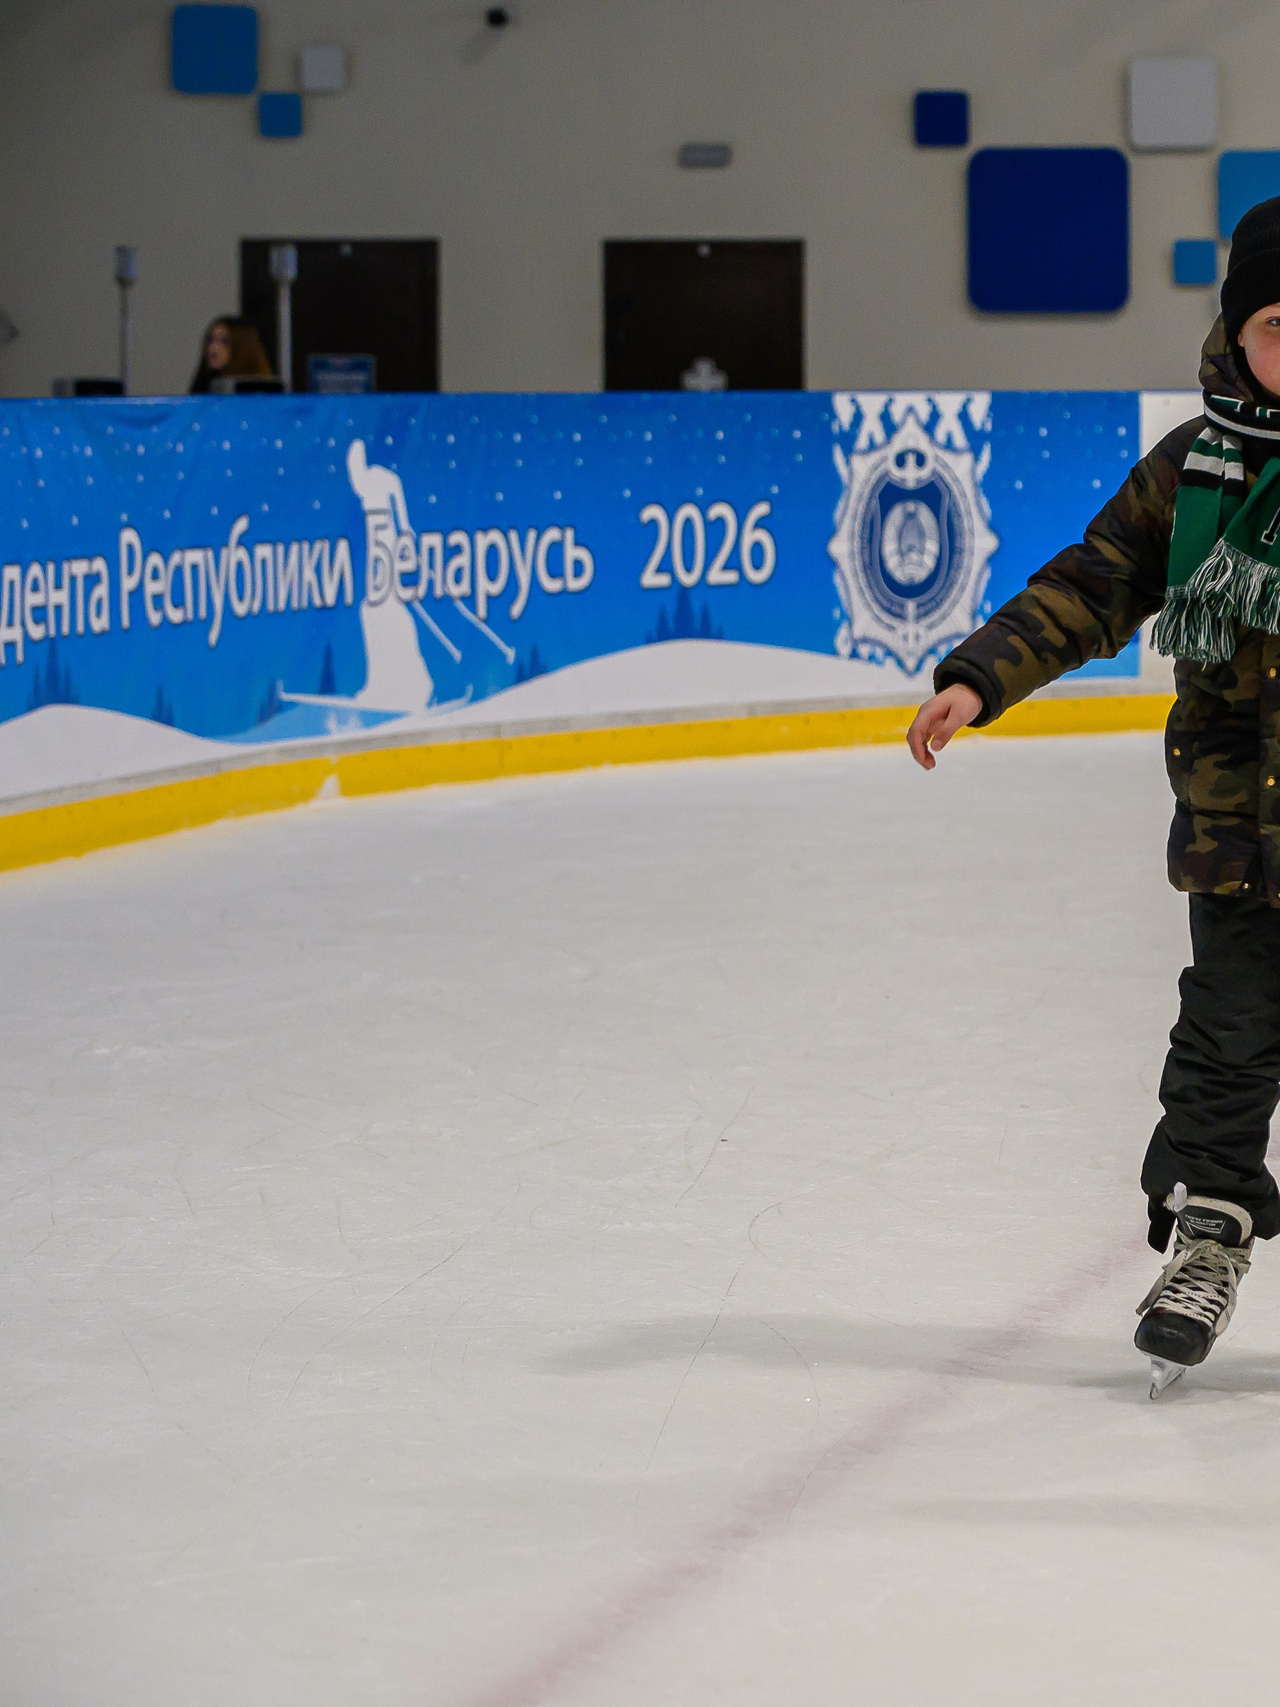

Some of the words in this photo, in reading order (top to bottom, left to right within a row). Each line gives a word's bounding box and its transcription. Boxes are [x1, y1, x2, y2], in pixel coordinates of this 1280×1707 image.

[118, 513, 354, 649] Республики
[365, 508, 595, 621] Беларусь
[638, 500, 777, 589] 2026
